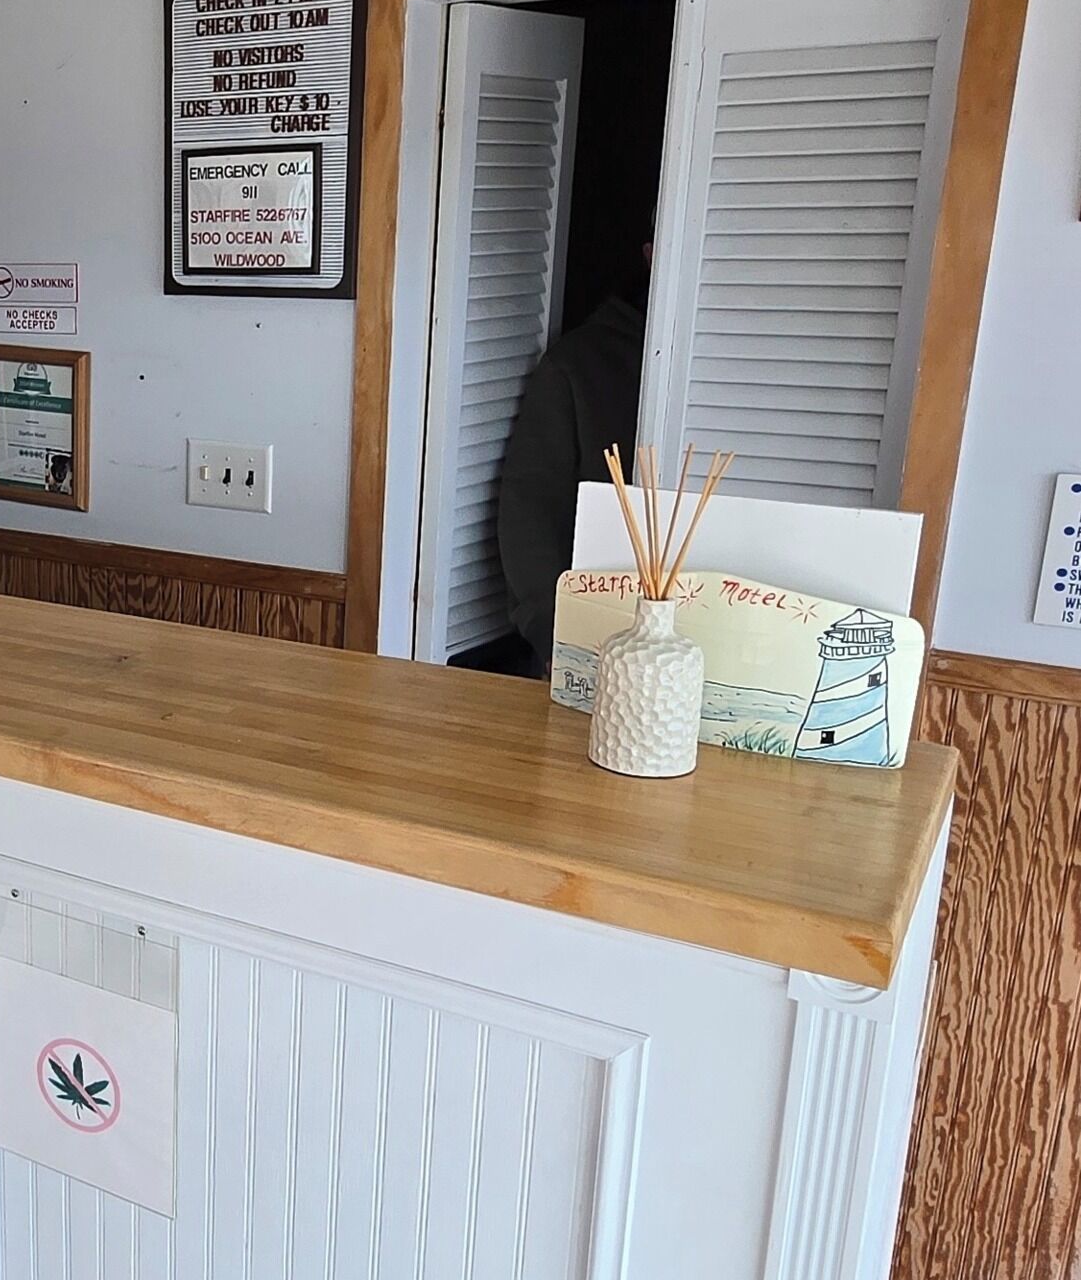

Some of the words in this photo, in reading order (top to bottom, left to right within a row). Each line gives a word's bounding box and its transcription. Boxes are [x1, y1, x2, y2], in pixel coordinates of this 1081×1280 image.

[195, 16, 244, 37] CHECK
[250, 13, 280, 32] OUT
[213, 50, 233, 67] NO
[238, 44, 304, 65] VISITORS
[213, 75, 232, 92] NO
[238, 70, 297, 91] REFUND
[180, 100, 214, 117] LOSE
[221, 97, 259, 115] YOUR
[265, 95, 294, 113] KEY
[314, 93, 330, 111] 10
[270, 113, 331, 133] CHARGE
[189, 163, 268, 181] EMERGENCY
[277, 162, 312, 176] CALL
[241, 186, 258, 199] 911
[190, 209, 251, 224] STARFIRE
[190, 232, 221, 245] 5100
[225, 231, 273, 245] OCEAN
[280, 231, 308, 244] AVE.
[214, 253, 286, 267] WILDWOOD
[15, 278, 29, 288] NO
[30, 278, 74, 288] SMOKING
[6, 310, 18, 319] NO
[22, 310, 58, 320] CHECKS
[9, 320, 56, 330] ACCEPTED
